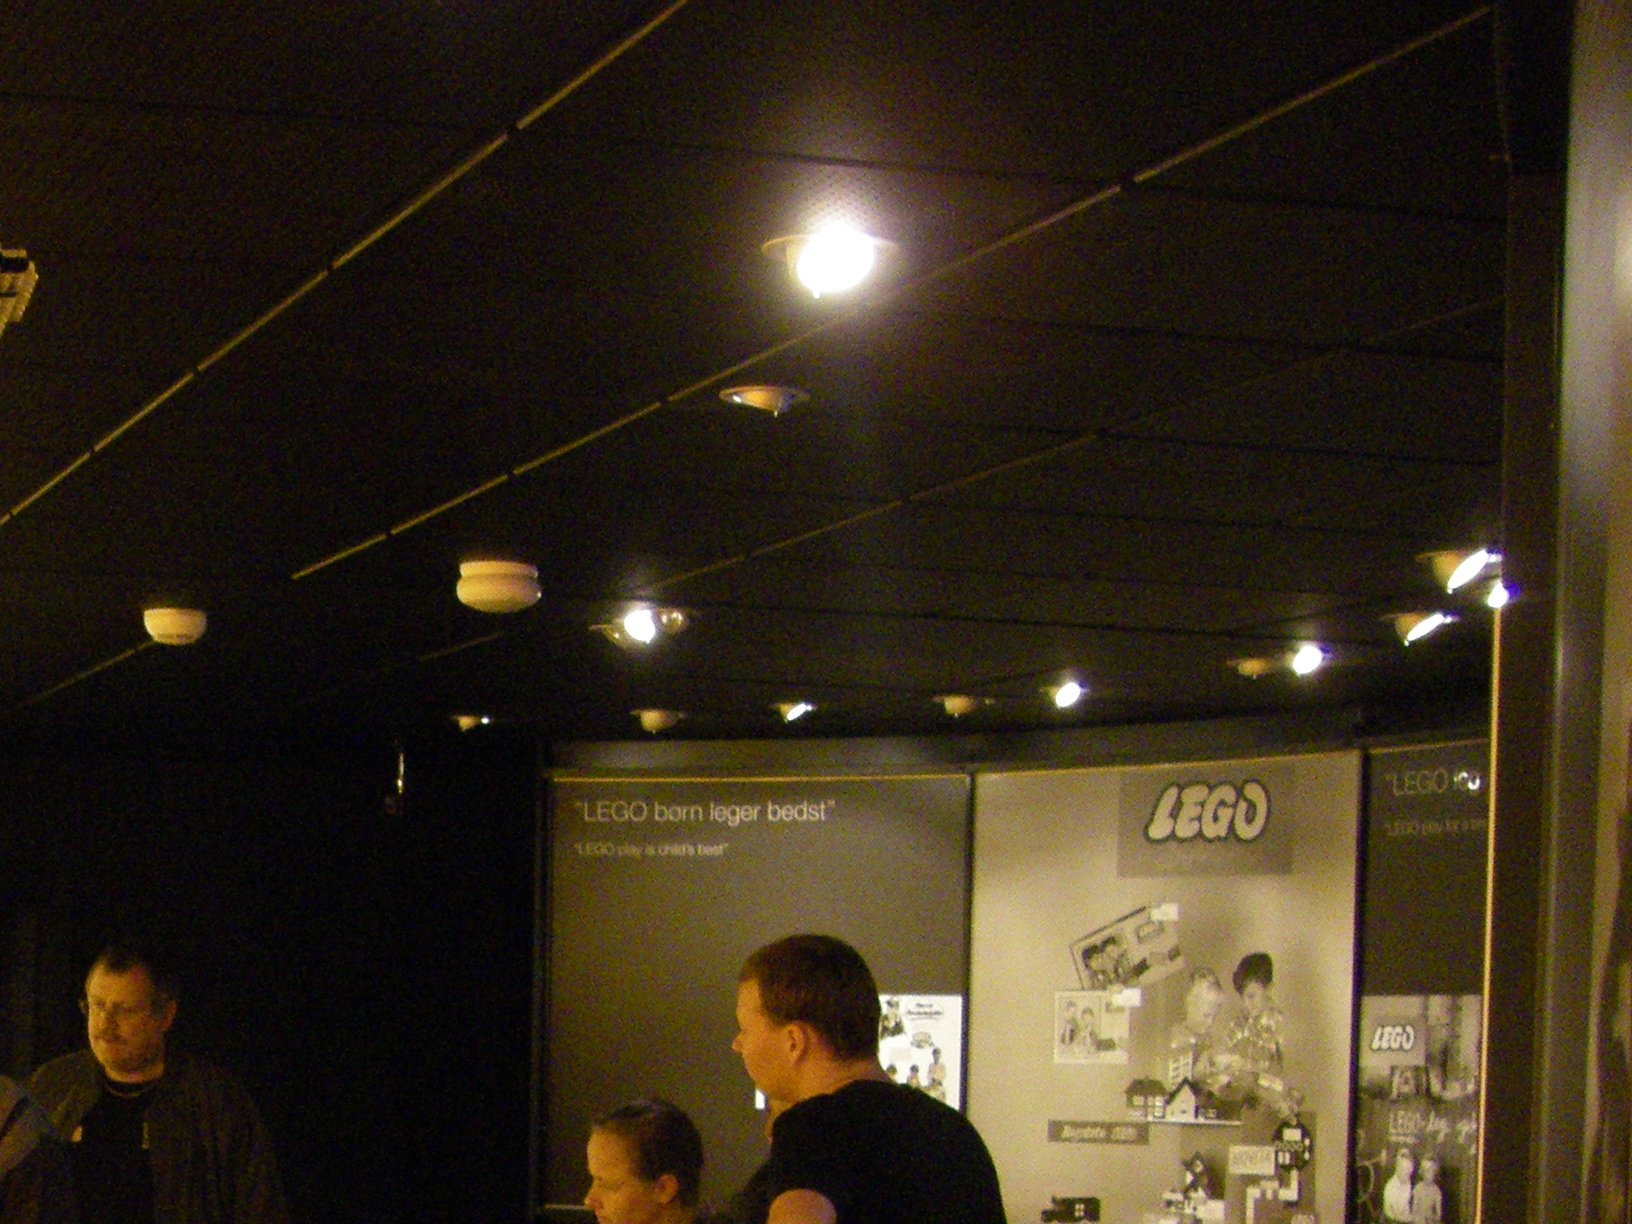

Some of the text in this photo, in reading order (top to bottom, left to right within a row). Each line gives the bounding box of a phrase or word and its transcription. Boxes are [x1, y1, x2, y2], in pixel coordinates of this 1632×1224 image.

[709, 801, 761, 827] leger
[1145, 778, 1272, 844] LEGO
[1370, 1023, 1416, 1052] LEGO
